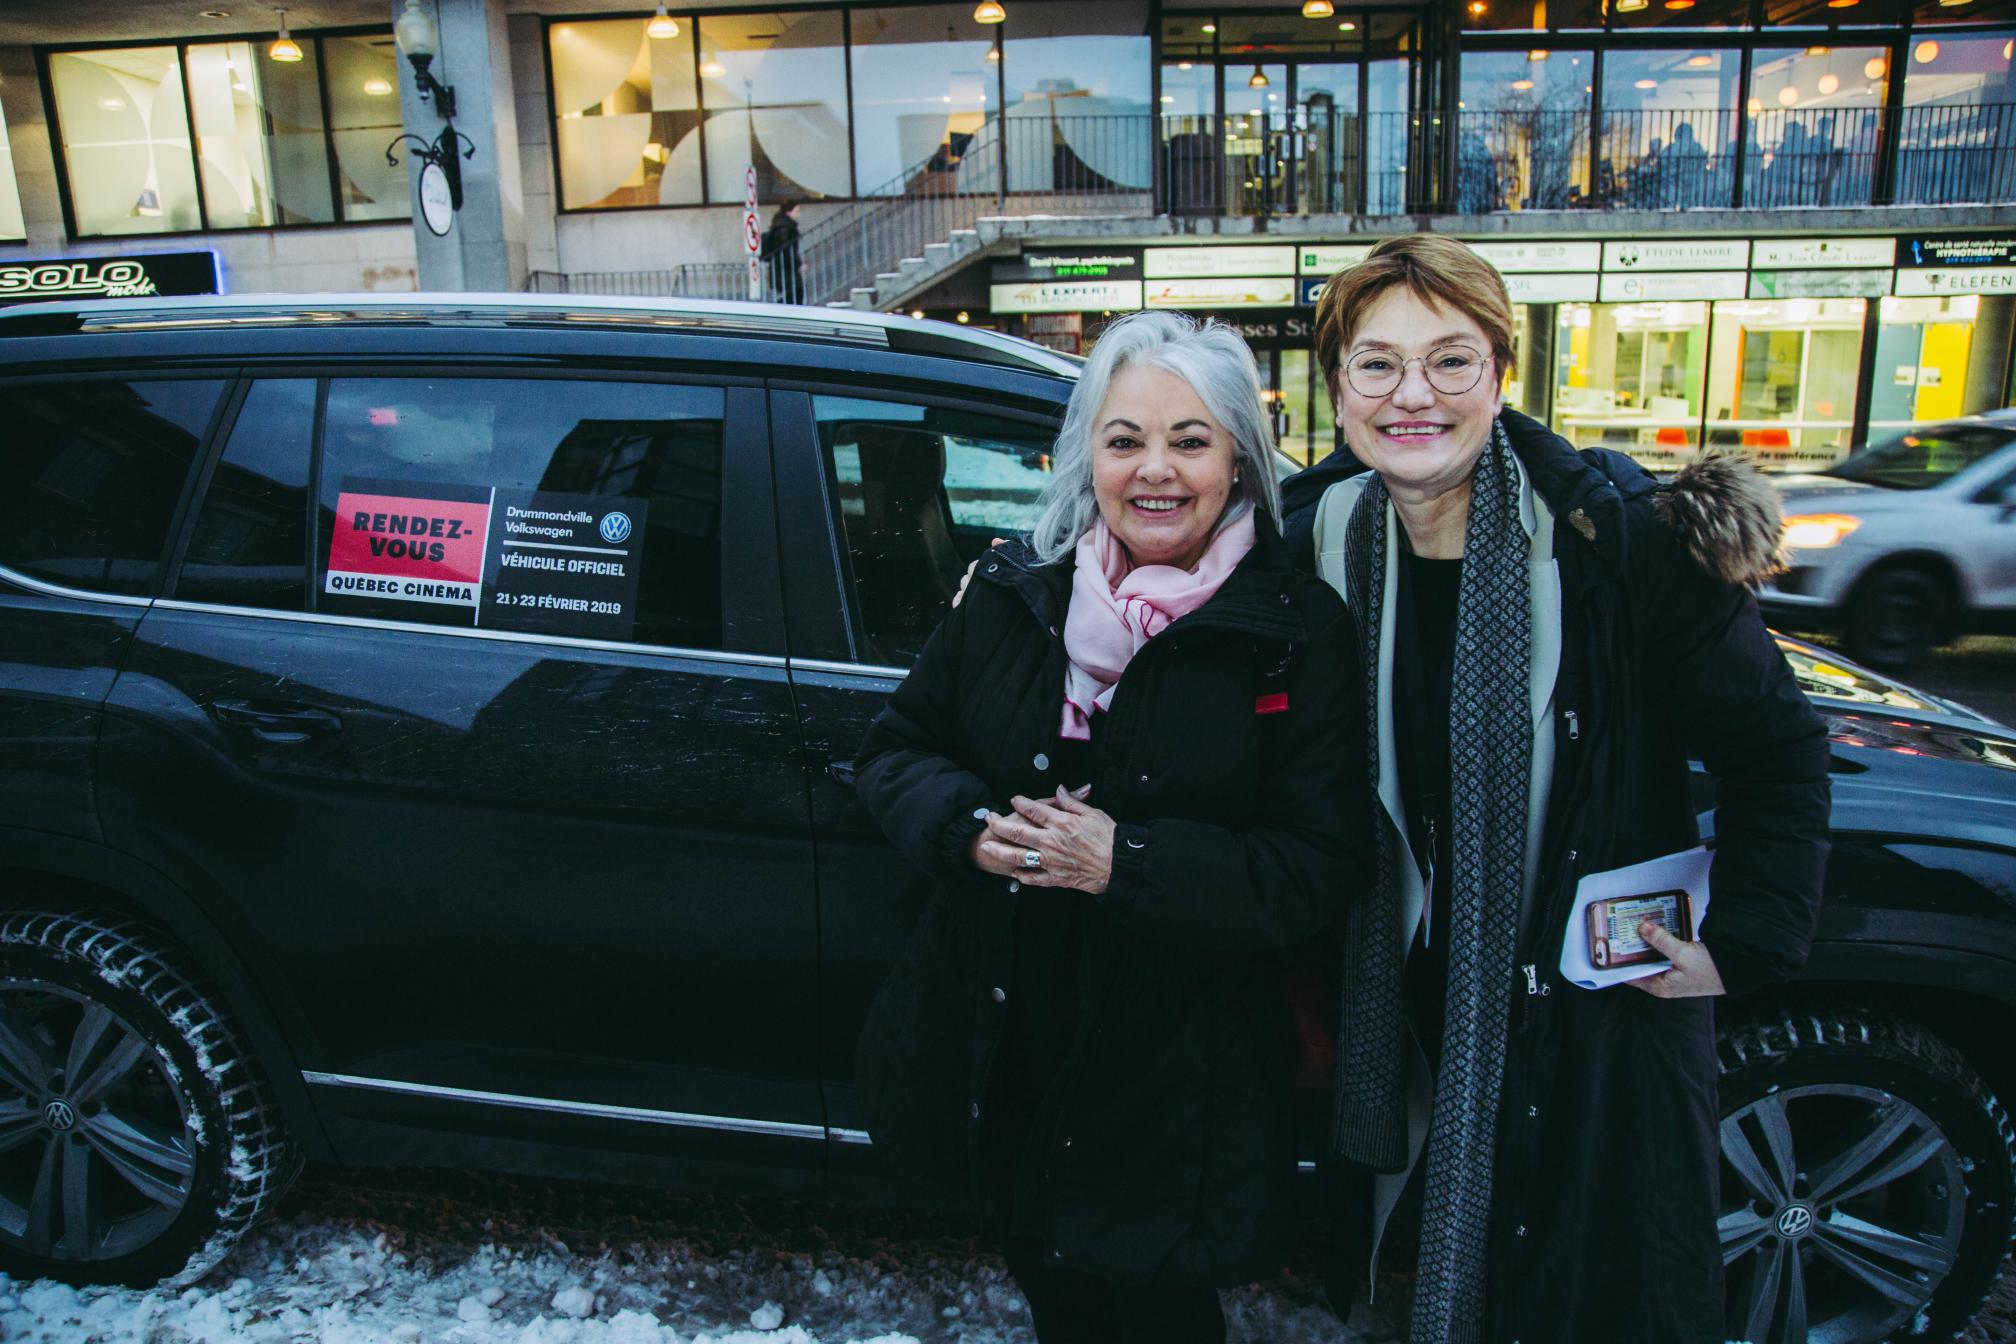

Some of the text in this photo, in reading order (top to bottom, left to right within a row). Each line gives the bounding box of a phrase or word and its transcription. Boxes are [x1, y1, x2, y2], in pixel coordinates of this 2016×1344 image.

[1936, 247, 2008, 258] HYPNOTHÉRAPIE
[1945, 240, 1953, 249] de
[0, 261, 144, 293] SOLO
[1950, 275, 2012, 289] ELEFEN
[1774, 450, 1837, 460] conférence
[506, 506, 593, 523] Drummondville
[353, 511, 473, 539] RENDEZ-
[505, 521, 574, 538] Volkswagen
[369, 536, 445, 563] VOUS
[501, 552, 626, 577] VÉHICULE OFFICIEL
[331, 575, 473, 601] QUÉBEC CINÉMA
[496, 592, 511, 605] 21
[521, 594, 536, 607] 23
[538, 594, 588, 611] FÉVRIER
[590, 600, 622, 615] 2019
